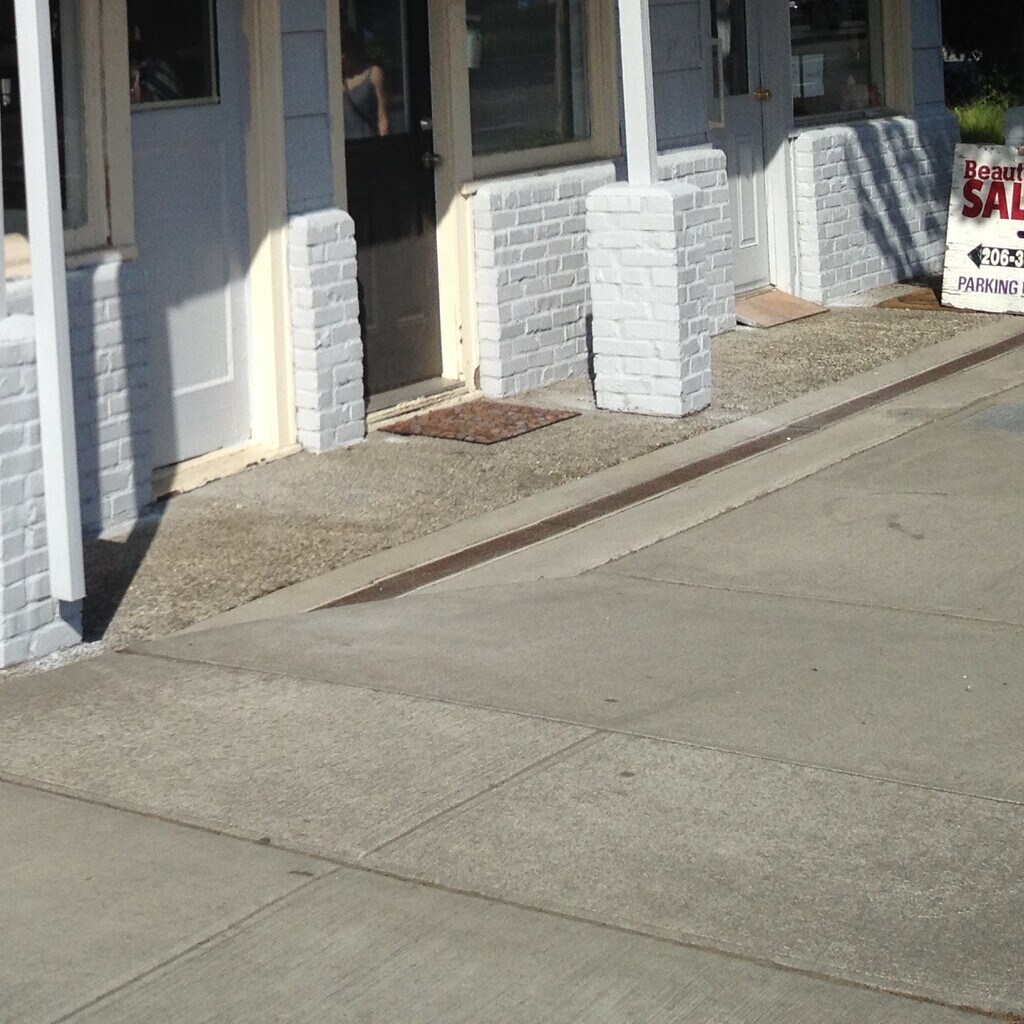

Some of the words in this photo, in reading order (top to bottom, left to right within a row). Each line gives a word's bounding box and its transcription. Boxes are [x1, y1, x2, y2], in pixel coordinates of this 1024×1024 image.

[962, 178, 1024, 220] SAL
[981, 247, 1024, 267] 206-3
[958, 276, 1018, 295] PARKING
